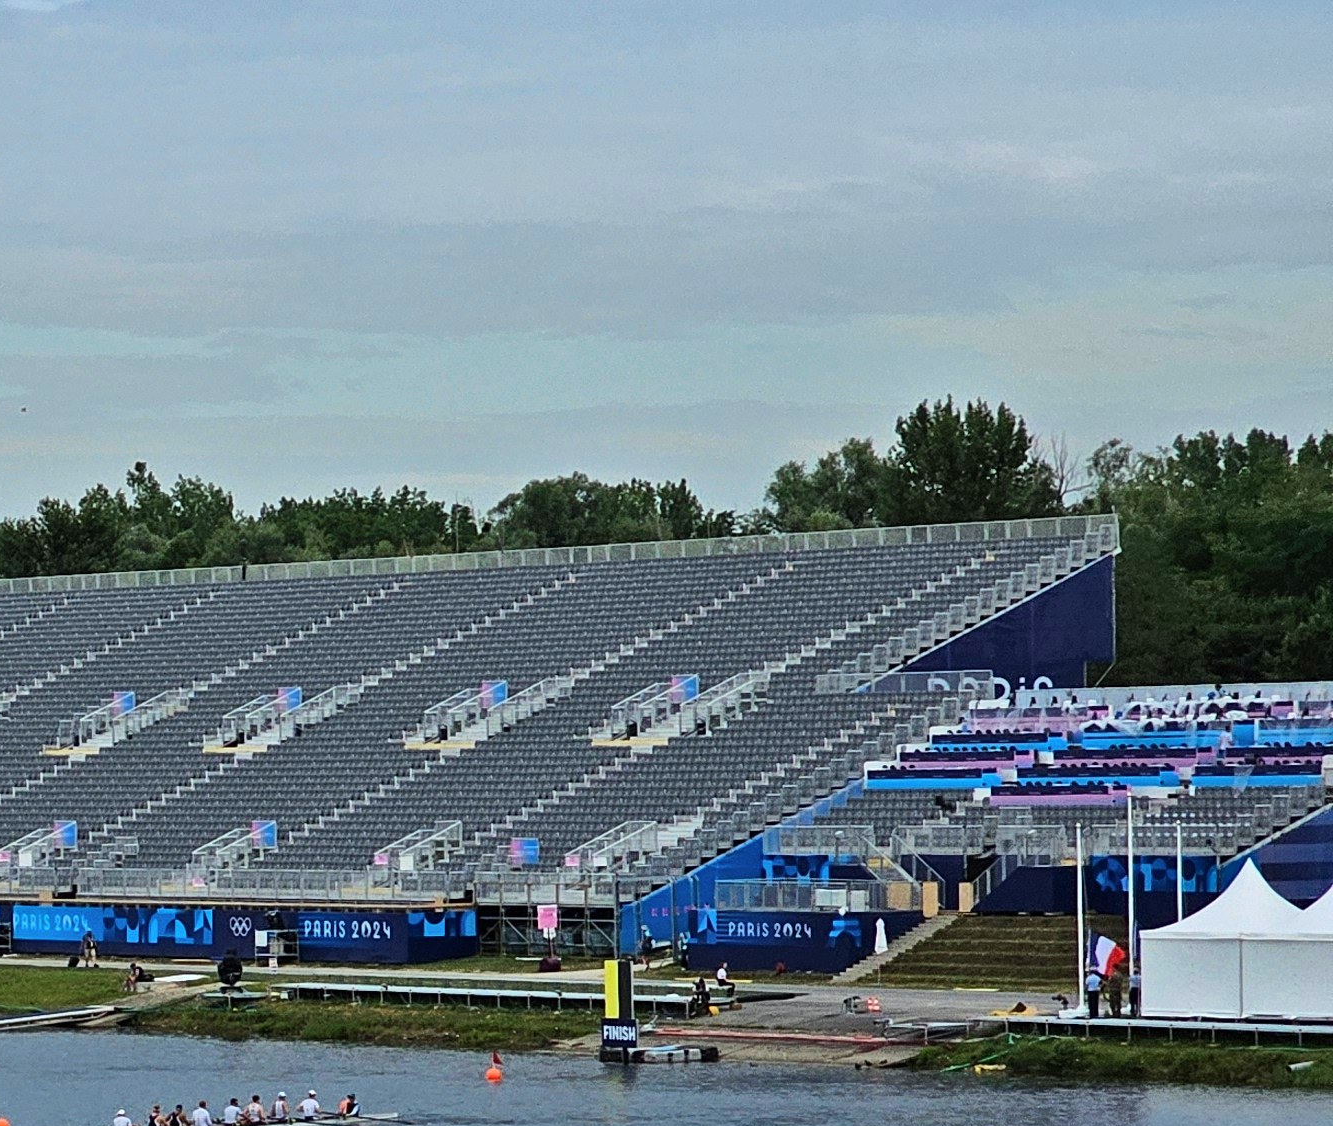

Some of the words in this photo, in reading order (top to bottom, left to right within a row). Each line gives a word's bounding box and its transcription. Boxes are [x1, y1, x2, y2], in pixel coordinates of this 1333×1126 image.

[351, 920, 391, 939] 2024
[773, 922, 812, 938] 2024
[603, 1025, 636, 1041] FINISH
